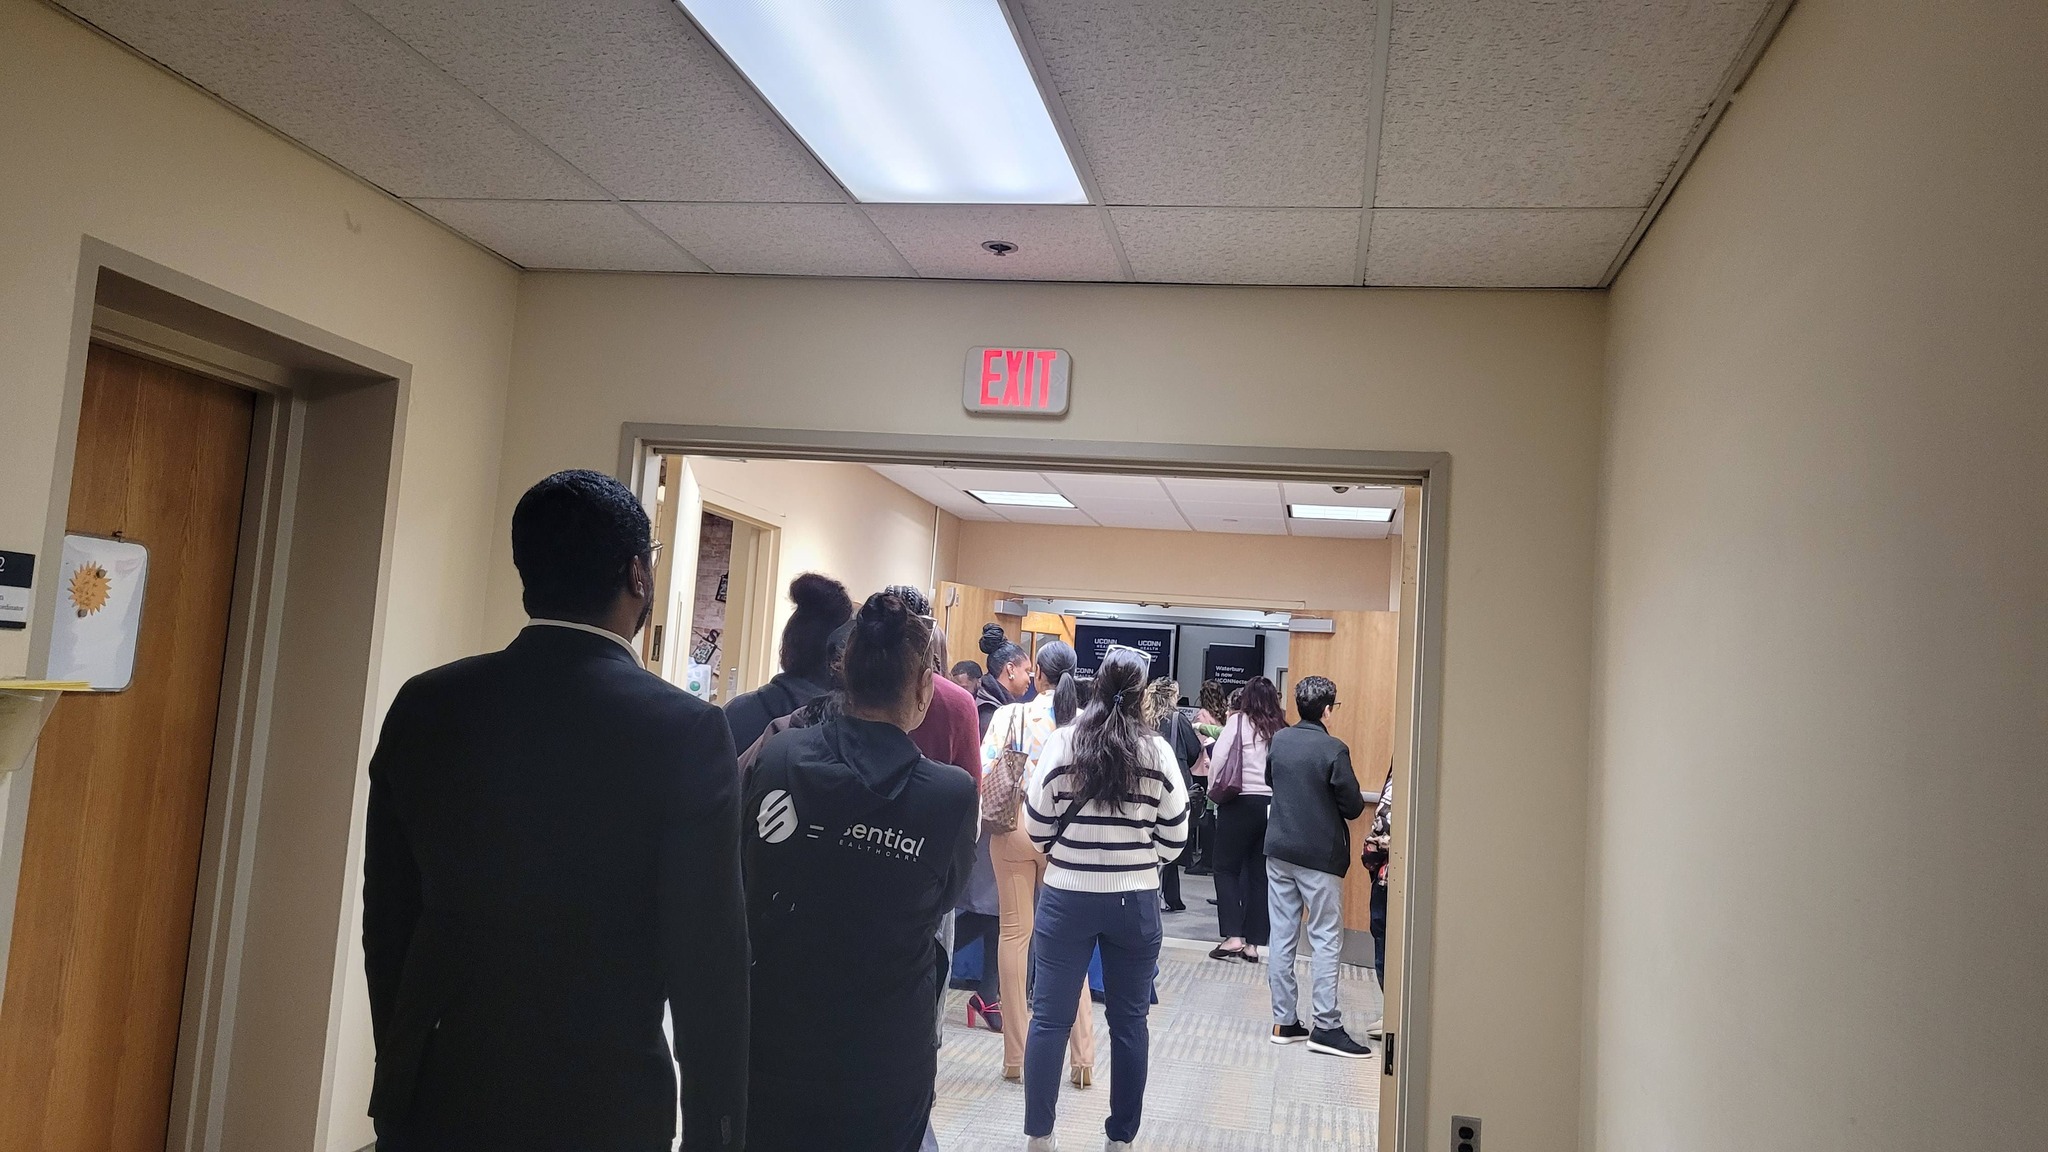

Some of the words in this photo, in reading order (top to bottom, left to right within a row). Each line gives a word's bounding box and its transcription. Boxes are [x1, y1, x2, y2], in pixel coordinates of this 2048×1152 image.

[980, 349, 1057, 408] EXIT
[1215, 665, 1245, 673] Waterbury
[839, 839, 918, 863] EALTHCARE
